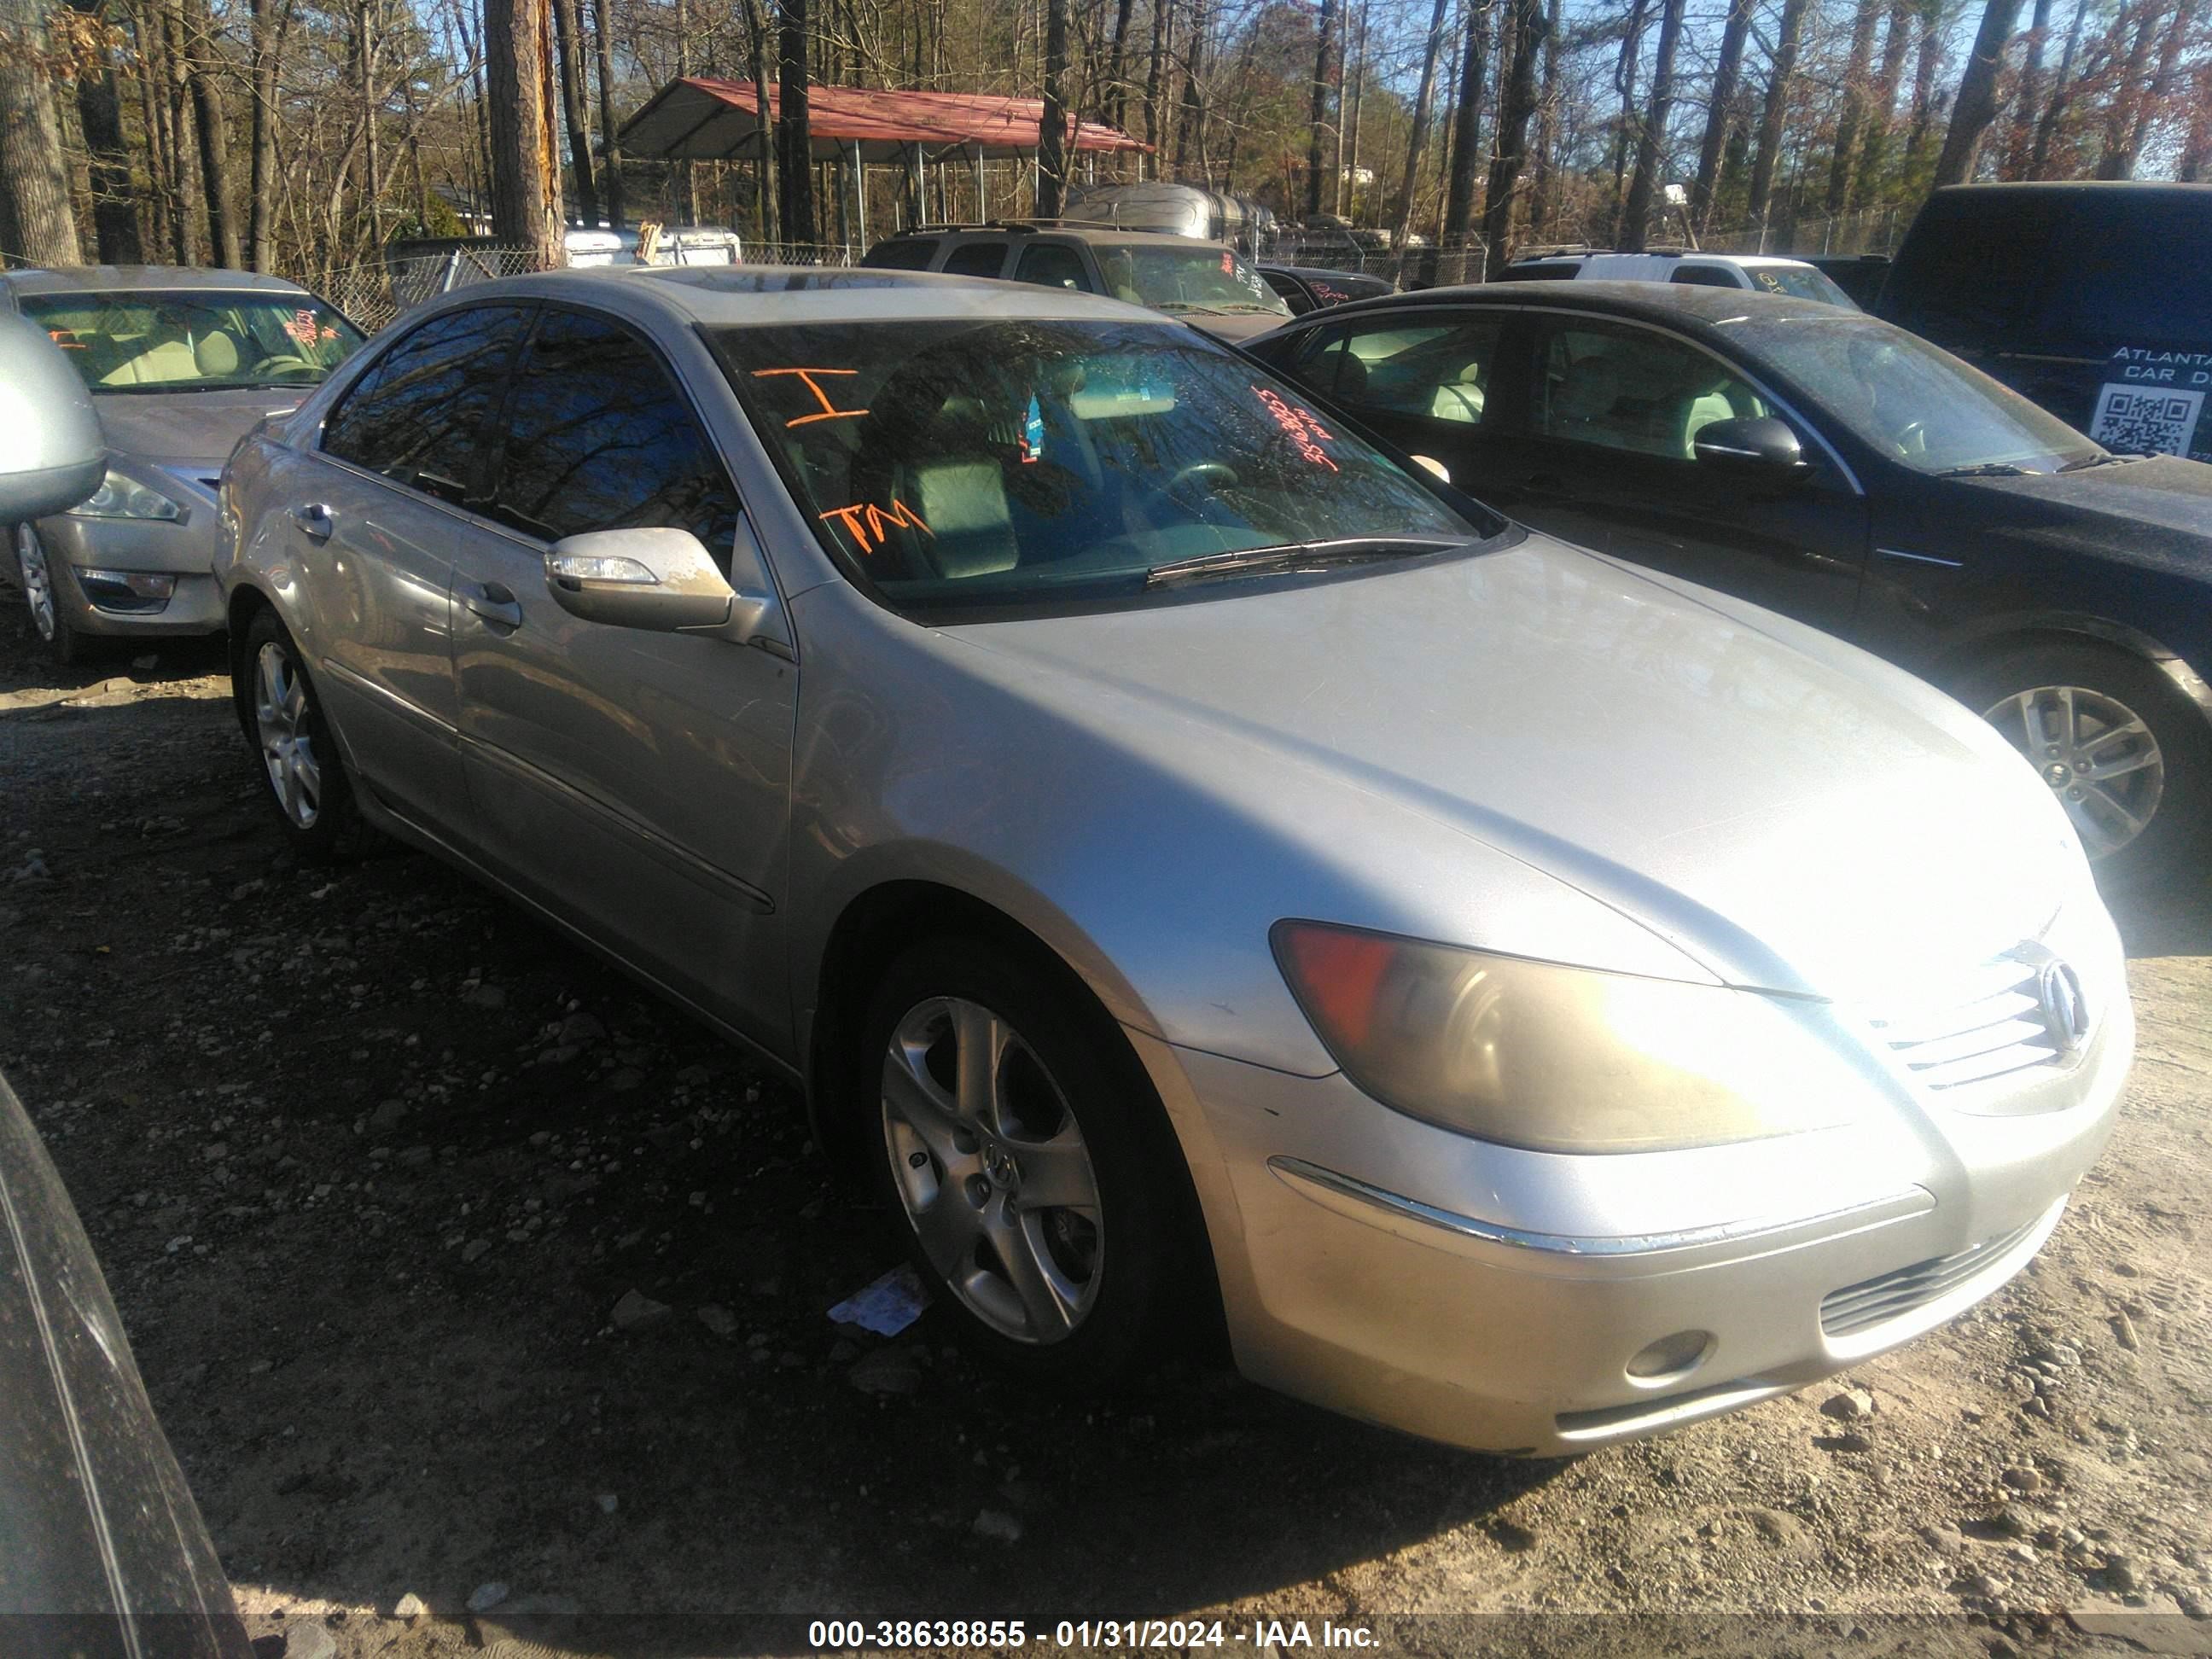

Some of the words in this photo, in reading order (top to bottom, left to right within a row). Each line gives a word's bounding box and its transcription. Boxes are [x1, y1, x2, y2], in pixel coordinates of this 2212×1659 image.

[751, 368, 870, 428] I
[2125, 365, 2175, 381] CAR
[2192, 371, 2212, 384] D
[818, 498, 935, 554] TM
